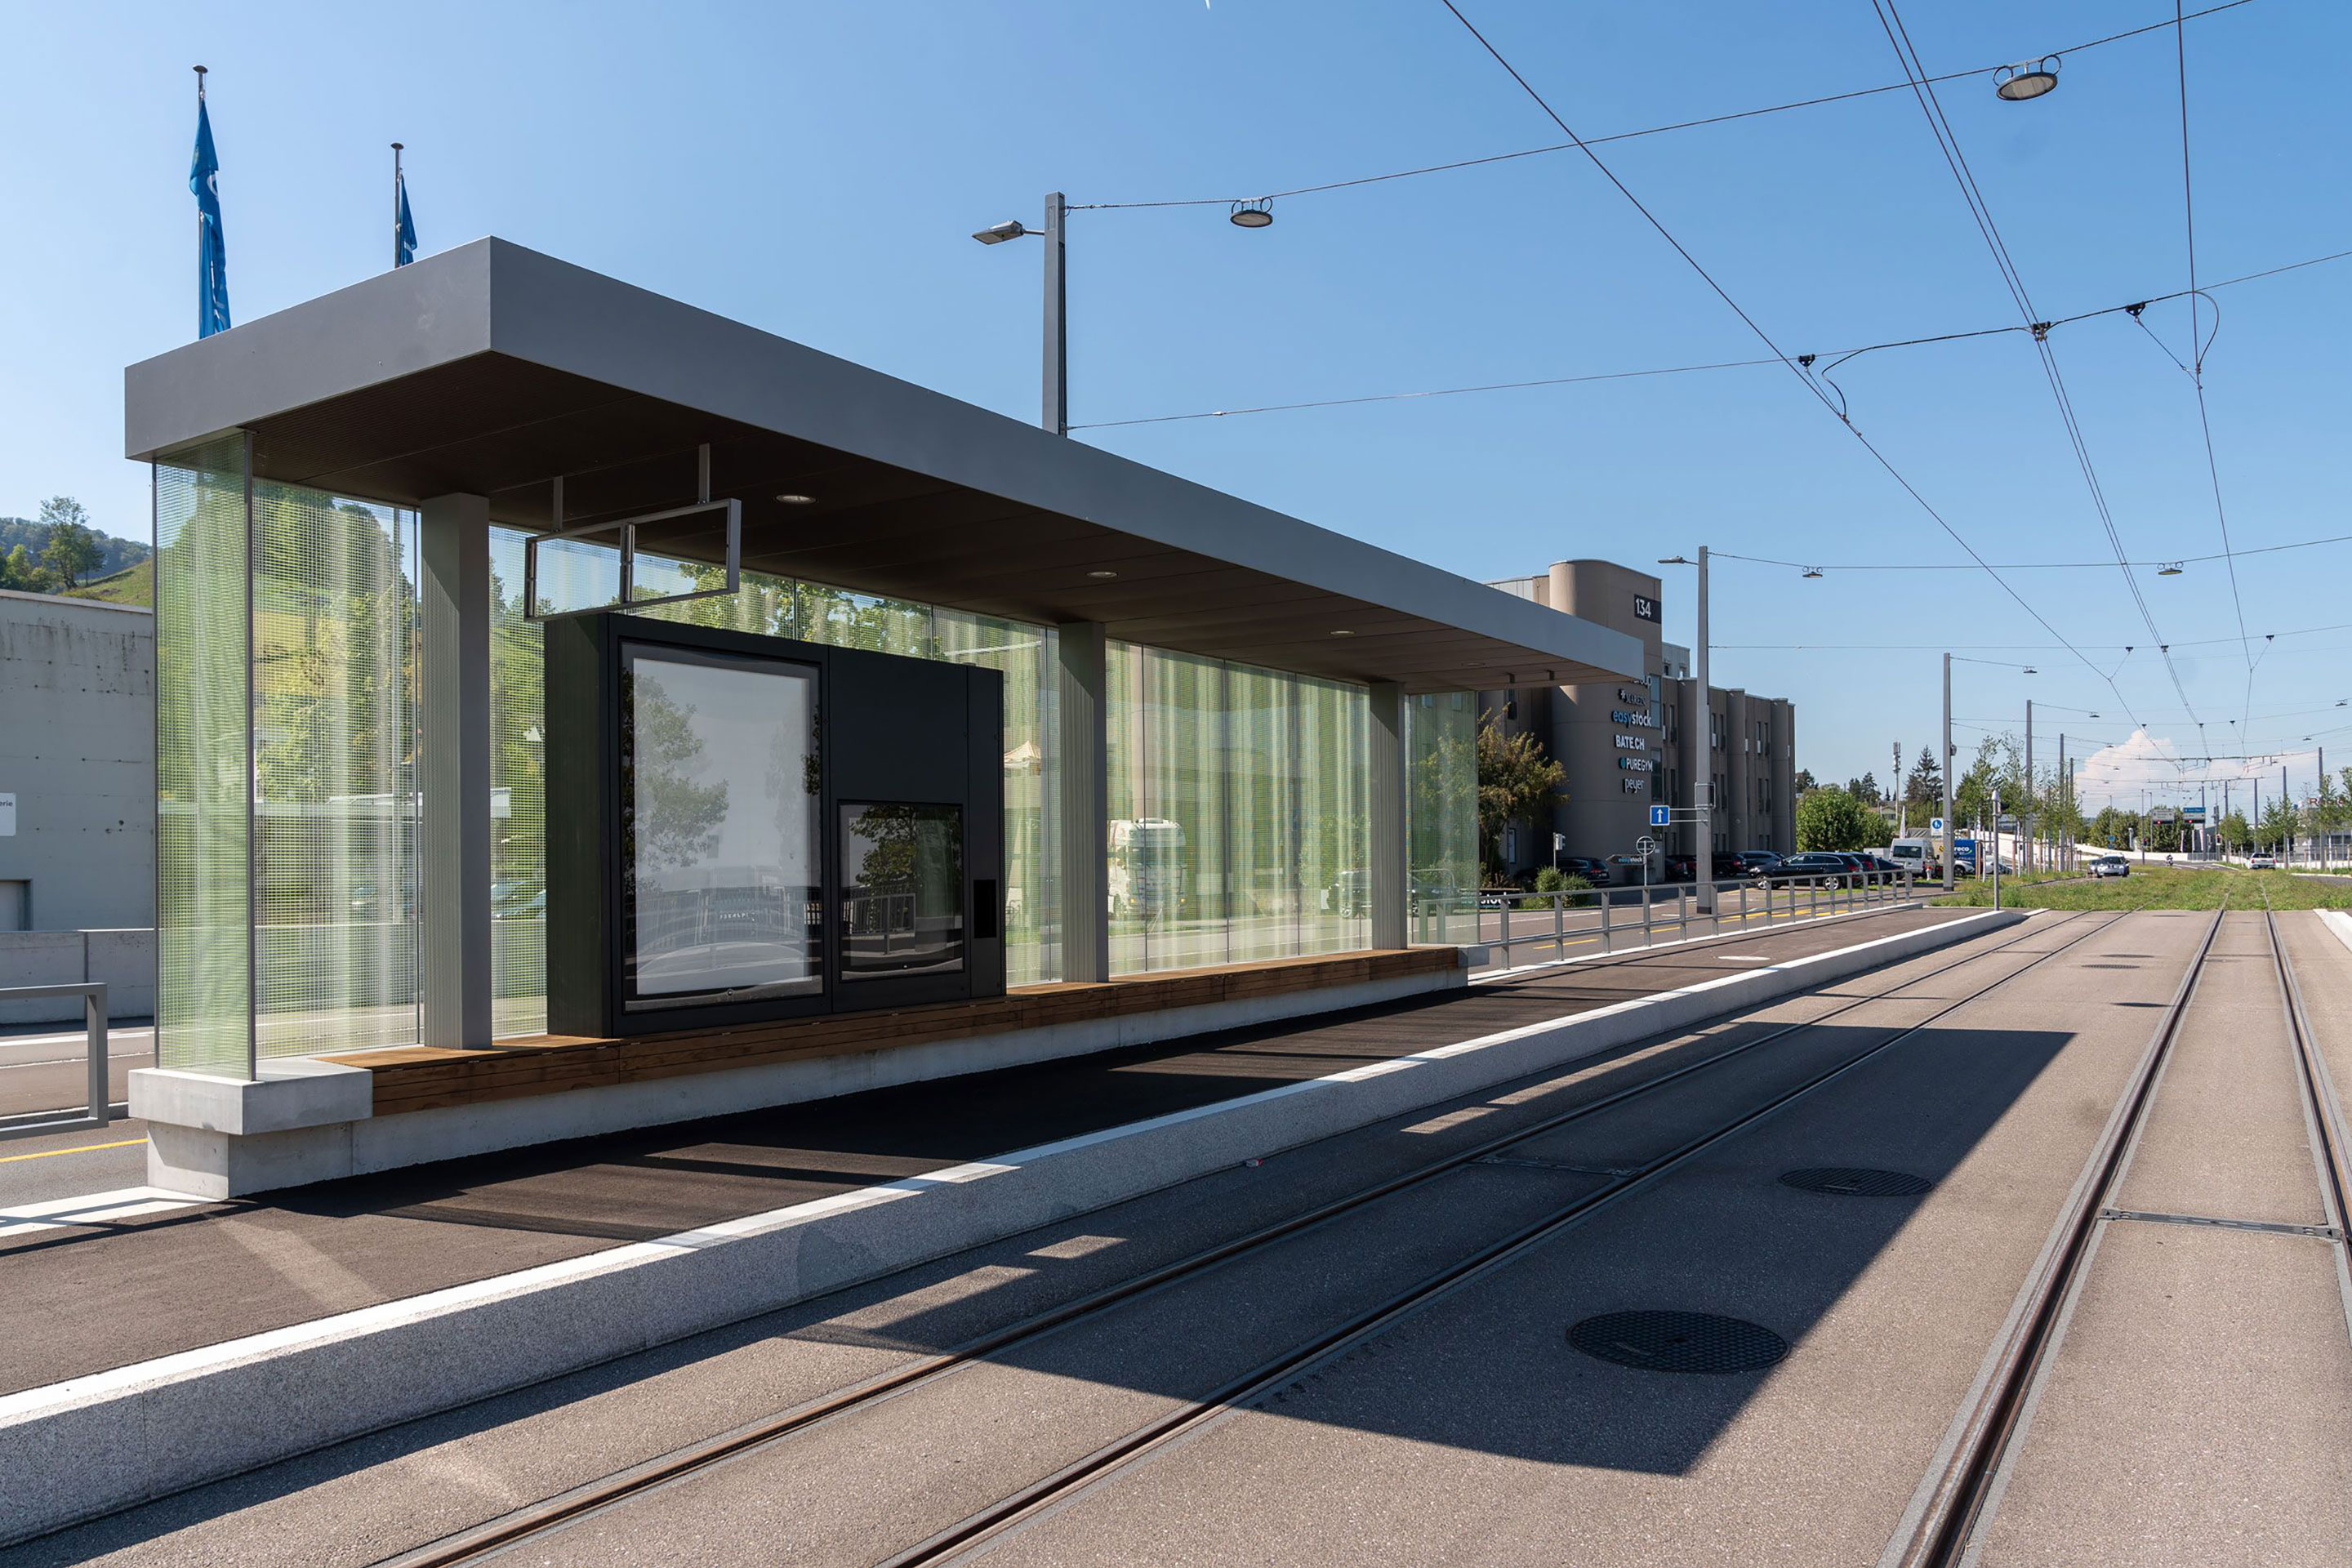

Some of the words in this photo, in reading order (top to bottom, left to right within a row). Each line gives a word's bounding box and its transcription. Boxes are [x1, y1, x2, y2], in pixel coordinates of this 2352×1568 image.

[1636, 598, 1651, 617] 134
[1612, 710, 1652, 728] easystock
[1626, 758, 1653, 773] PUREGYM
[1624, 778, 1645, 794] peyer
